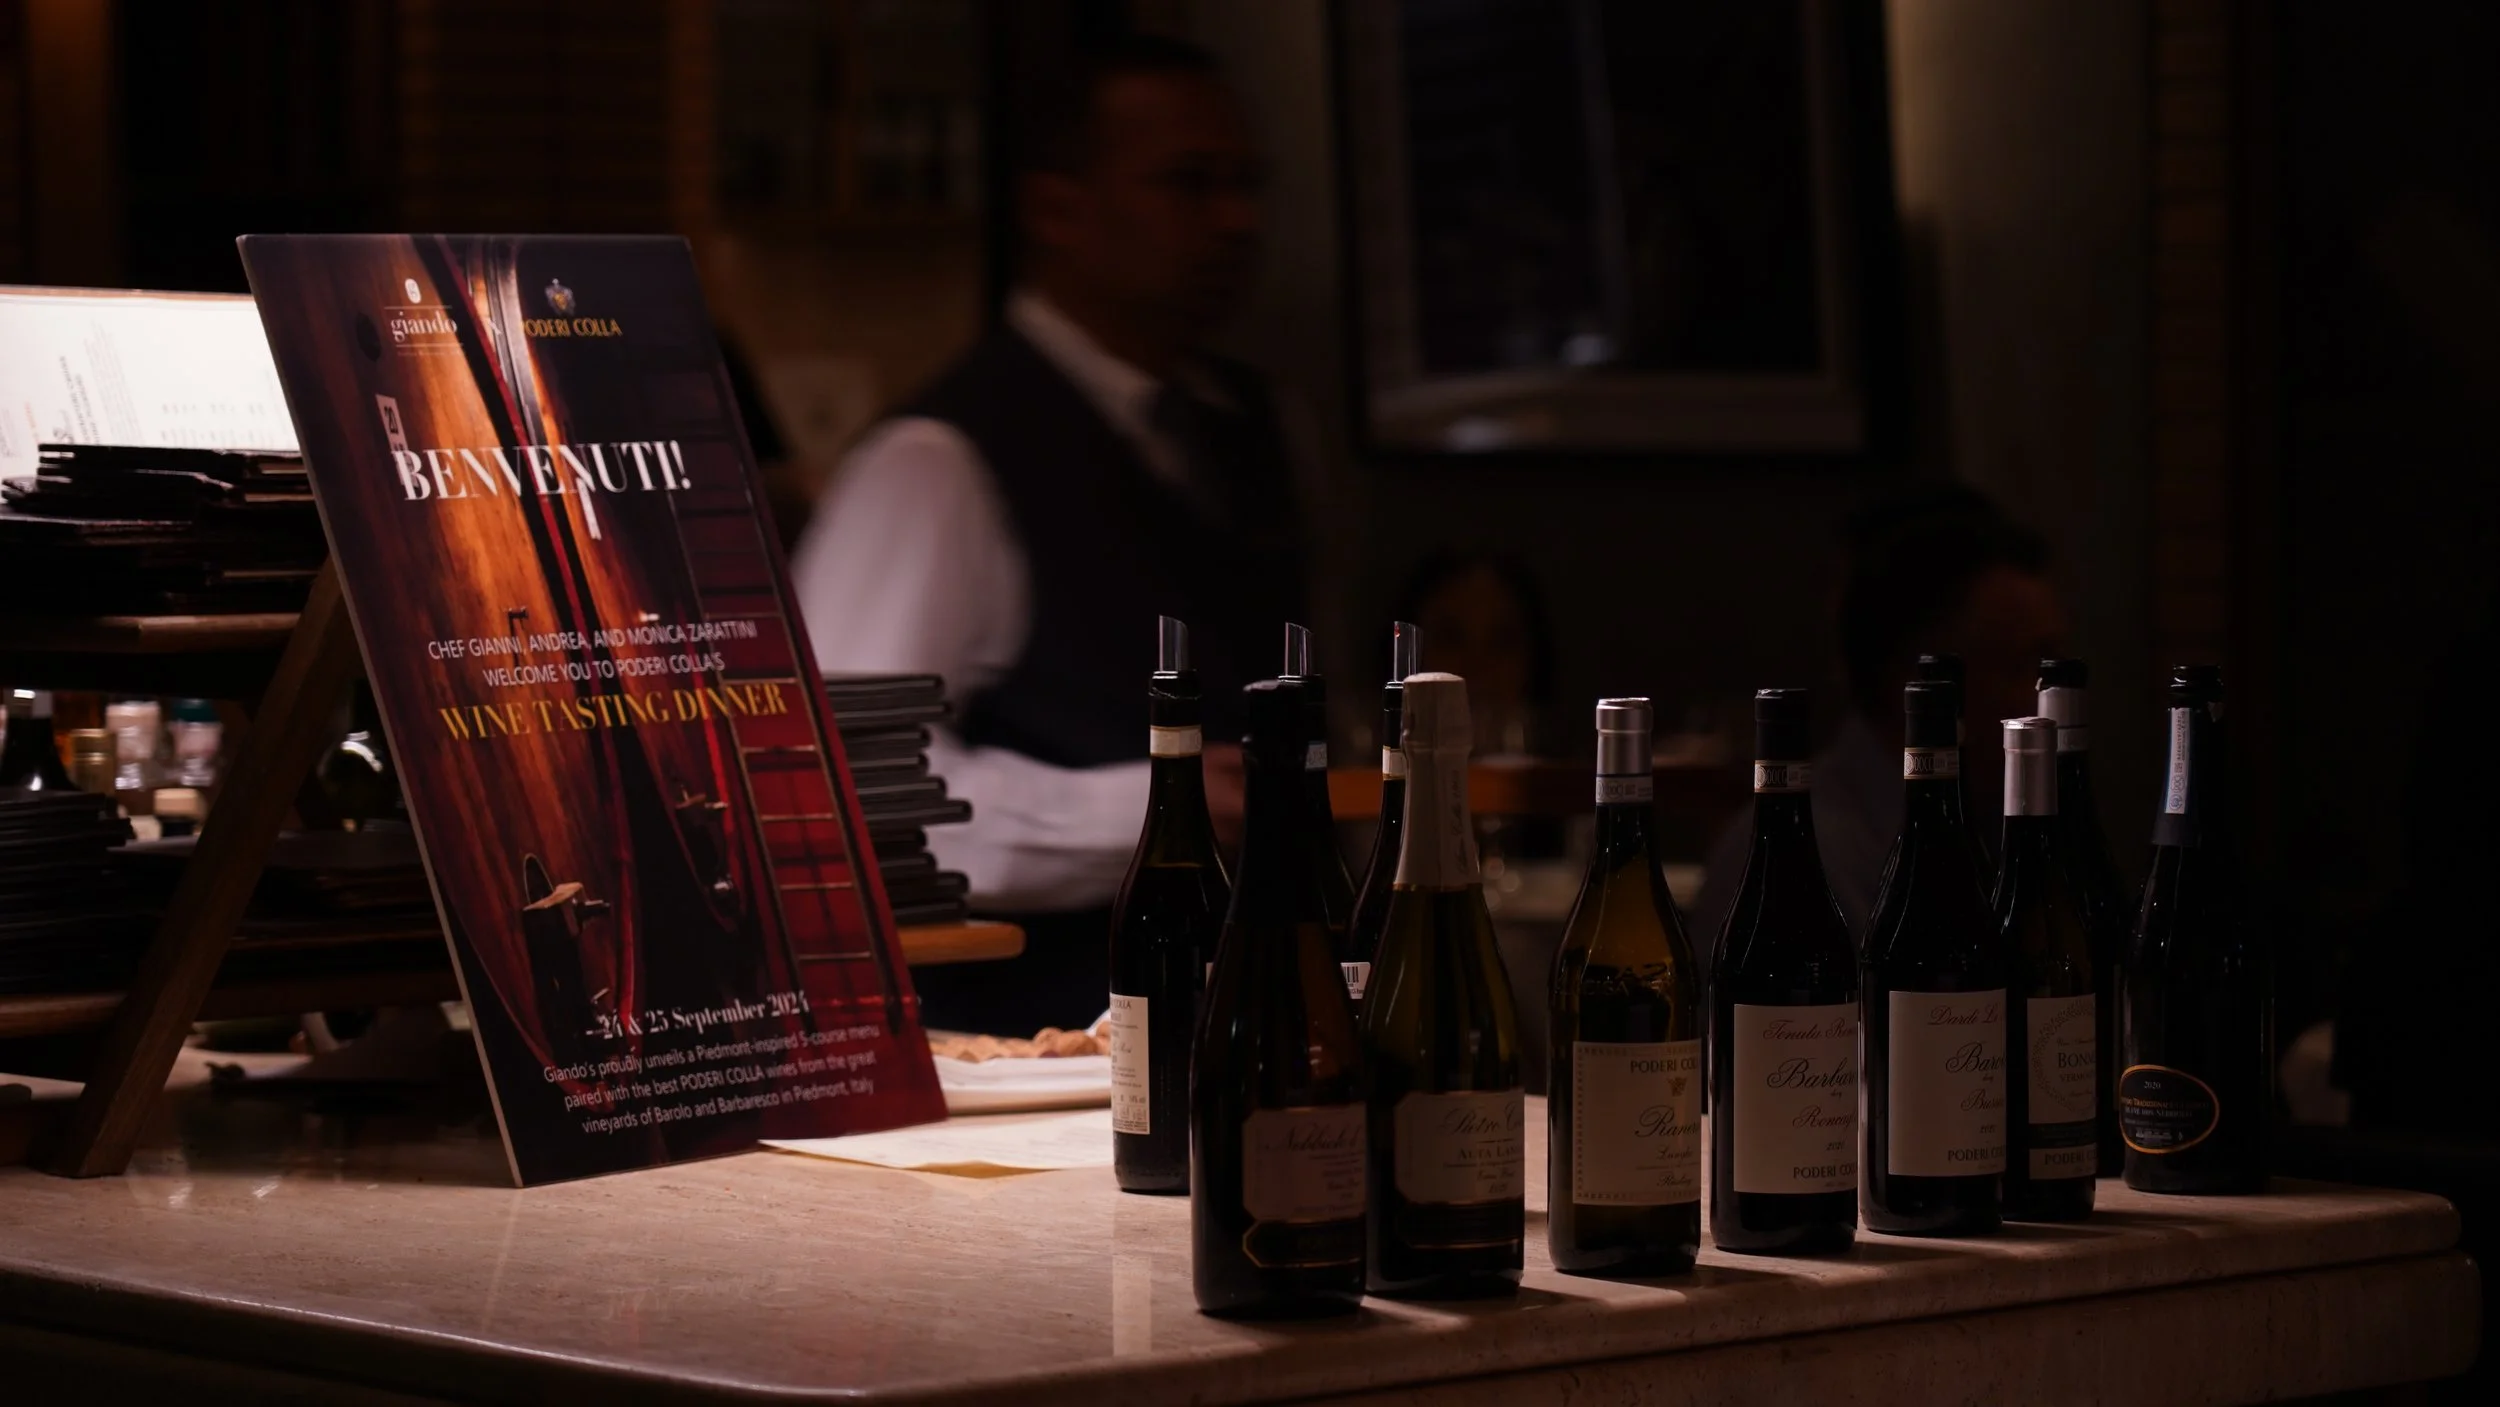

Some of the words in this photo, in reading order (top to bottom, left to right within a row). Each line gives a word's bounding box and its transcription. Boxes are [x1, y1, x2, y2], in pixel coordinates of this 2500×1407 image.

[390, 309, 459, 343] giando
[572, 316, 624, 338] COLLA
[391, 439, 693, 501] BENVENUTI!
[428, 640, 466, 660] CHEF
[469, 635, 526, 657] GIANNI,
[528, 630, 591, 653] ANDREA,
[594, 627, 626, 648] AND
[628, 623, 687, 645] MONICA
[687, 619, 758, 642] ZARATTINI
[482, 665, 558, 688] WELCOME
[558, 661, 592, 682] YOU
[592, 658, 615, 680] TO
[617, 655, 668, 678] PODERI
[438, 703, 531, 741] WINE
[533, 690, 670, 733] TASTING
[672, 682, 789, 723] DINNER
[645, 1007, 670, 1036] 25
[672, 997, 766, 1035] September
[766, 989, 811, 1019] 2024
[544, 1061, 597, 1084] Giando's
[598, 1054, 643, 1080] proudly
[645, 1049, 686, 1069] unveils
[687, 1051, 696, 1064] a
[696, 1032, 798, 1062] Piedmont-inspired
[849, 1023, 880, 1040] menu
[1630, 1059, 1677, 1074] PODERI
[564, 1089, 602, 1112] paired
[603, 1085, 630, 1104] with
[631, 1081, 653, 1101] the
[654, 1078, 680, 1097] best
[680, 1072, 725, 1093] PODERI
[726, 1065, 766, 1086] COLLA
[766, 1063, 798, 1081] wines
[798, 1056, 824, 1076] from
[825, 1053, 848, 1072] the
[848, 1049, 878, 1073] great
[581, 1109, 638, 1135] vineyards
[640, 1106, 653, 1126] of
[654, 1103, 693, 1124] Barolo
[694, 1099, 718, 1119] and
[719, 1092, 781, 1116] Barbaresco
[781, 1088, 793, 1104] in
[849, 1077, 875, 1098] Italy
[1793, 1166, 1836, 1179] PODERI
[1948, 1150, 1989, 1162] PODERI
